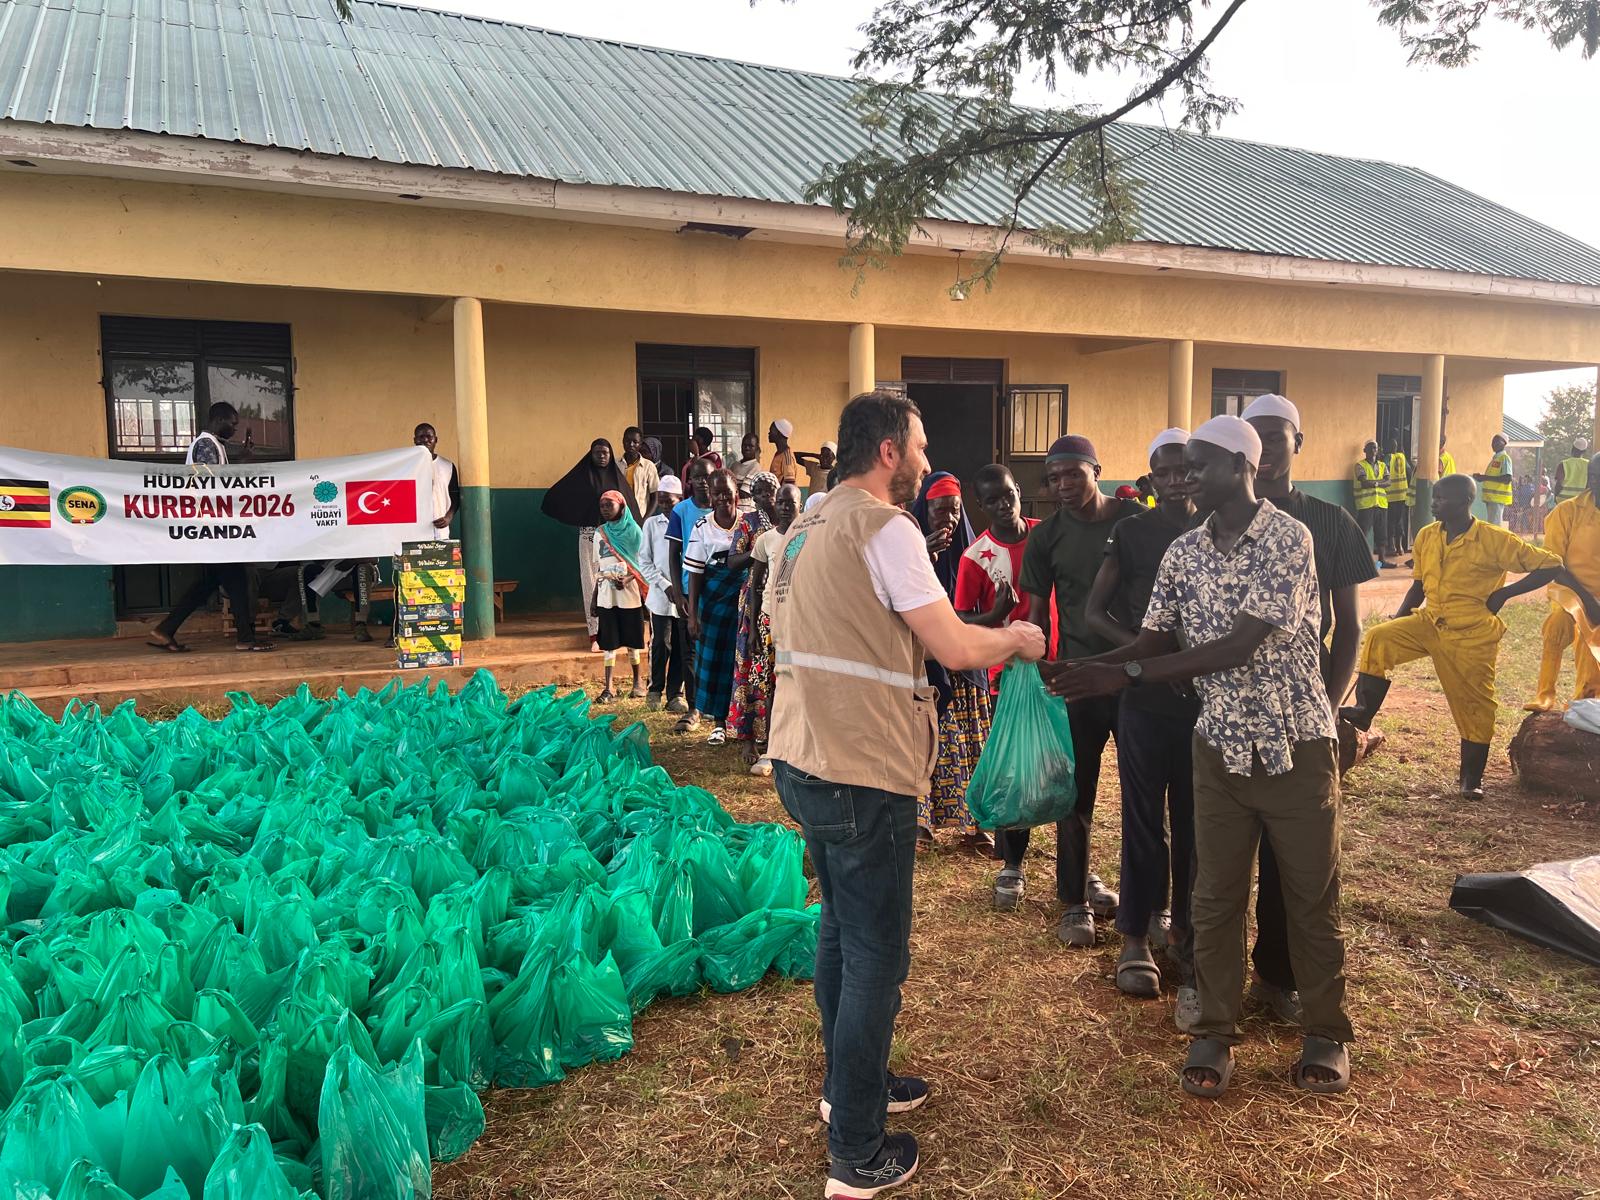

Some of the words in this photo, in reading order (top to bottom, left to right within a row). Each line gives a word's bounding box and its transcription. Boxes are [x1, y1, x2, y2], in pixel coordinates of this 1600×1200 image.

[219, 476, 276, 489] VAKFI
[68, 500, 96, 509] SENA
[123, 494, 234, 519] KURBAN
[238, 493, 296, 518] 2026
[315, 519, 338, 527] VAKFI
[168, 524, 257, 540] UGANDA
